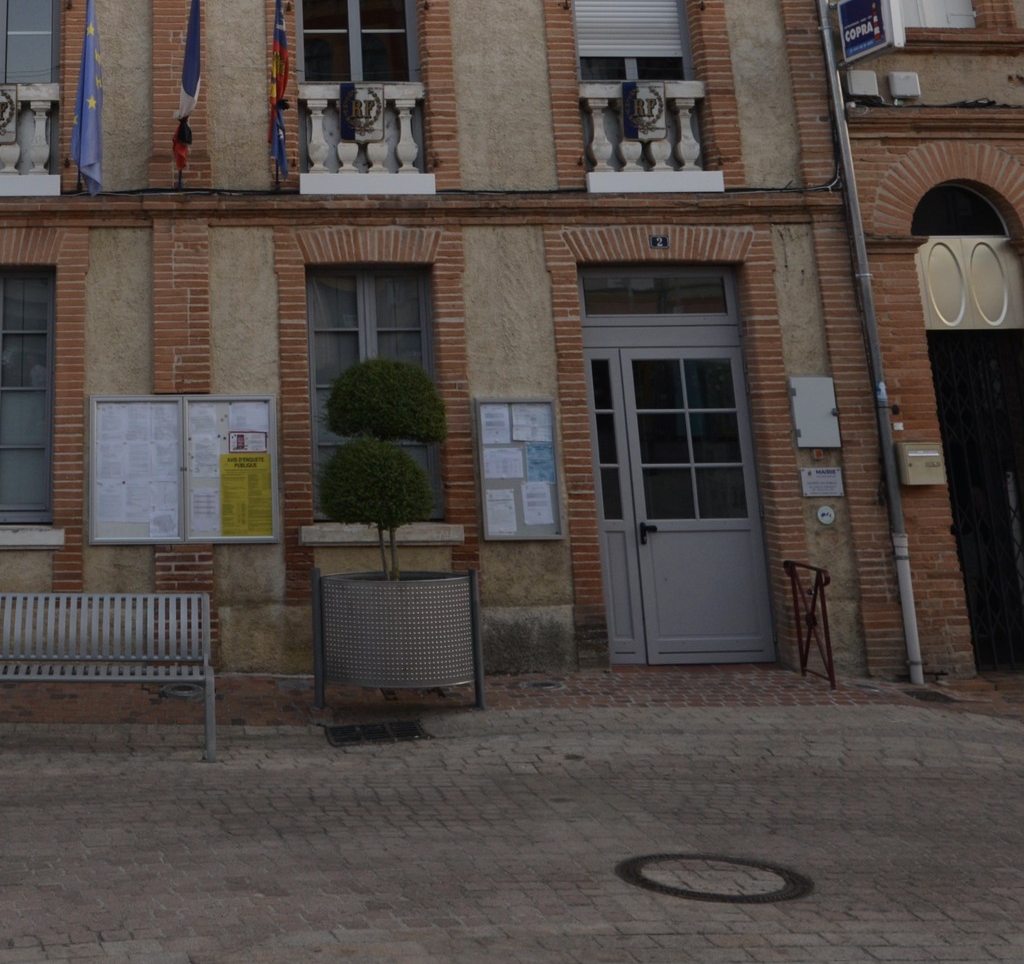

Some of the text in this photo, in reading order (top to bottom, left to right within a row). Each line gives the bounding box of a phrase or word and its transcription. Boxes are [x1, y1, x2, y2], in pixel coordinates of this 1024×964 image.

[845, 21, 874, 42] COPRA
[351, 100, 375, 118] RF
[633, 98, 657, 117] RF
[656, 237, 663, 246] 2
